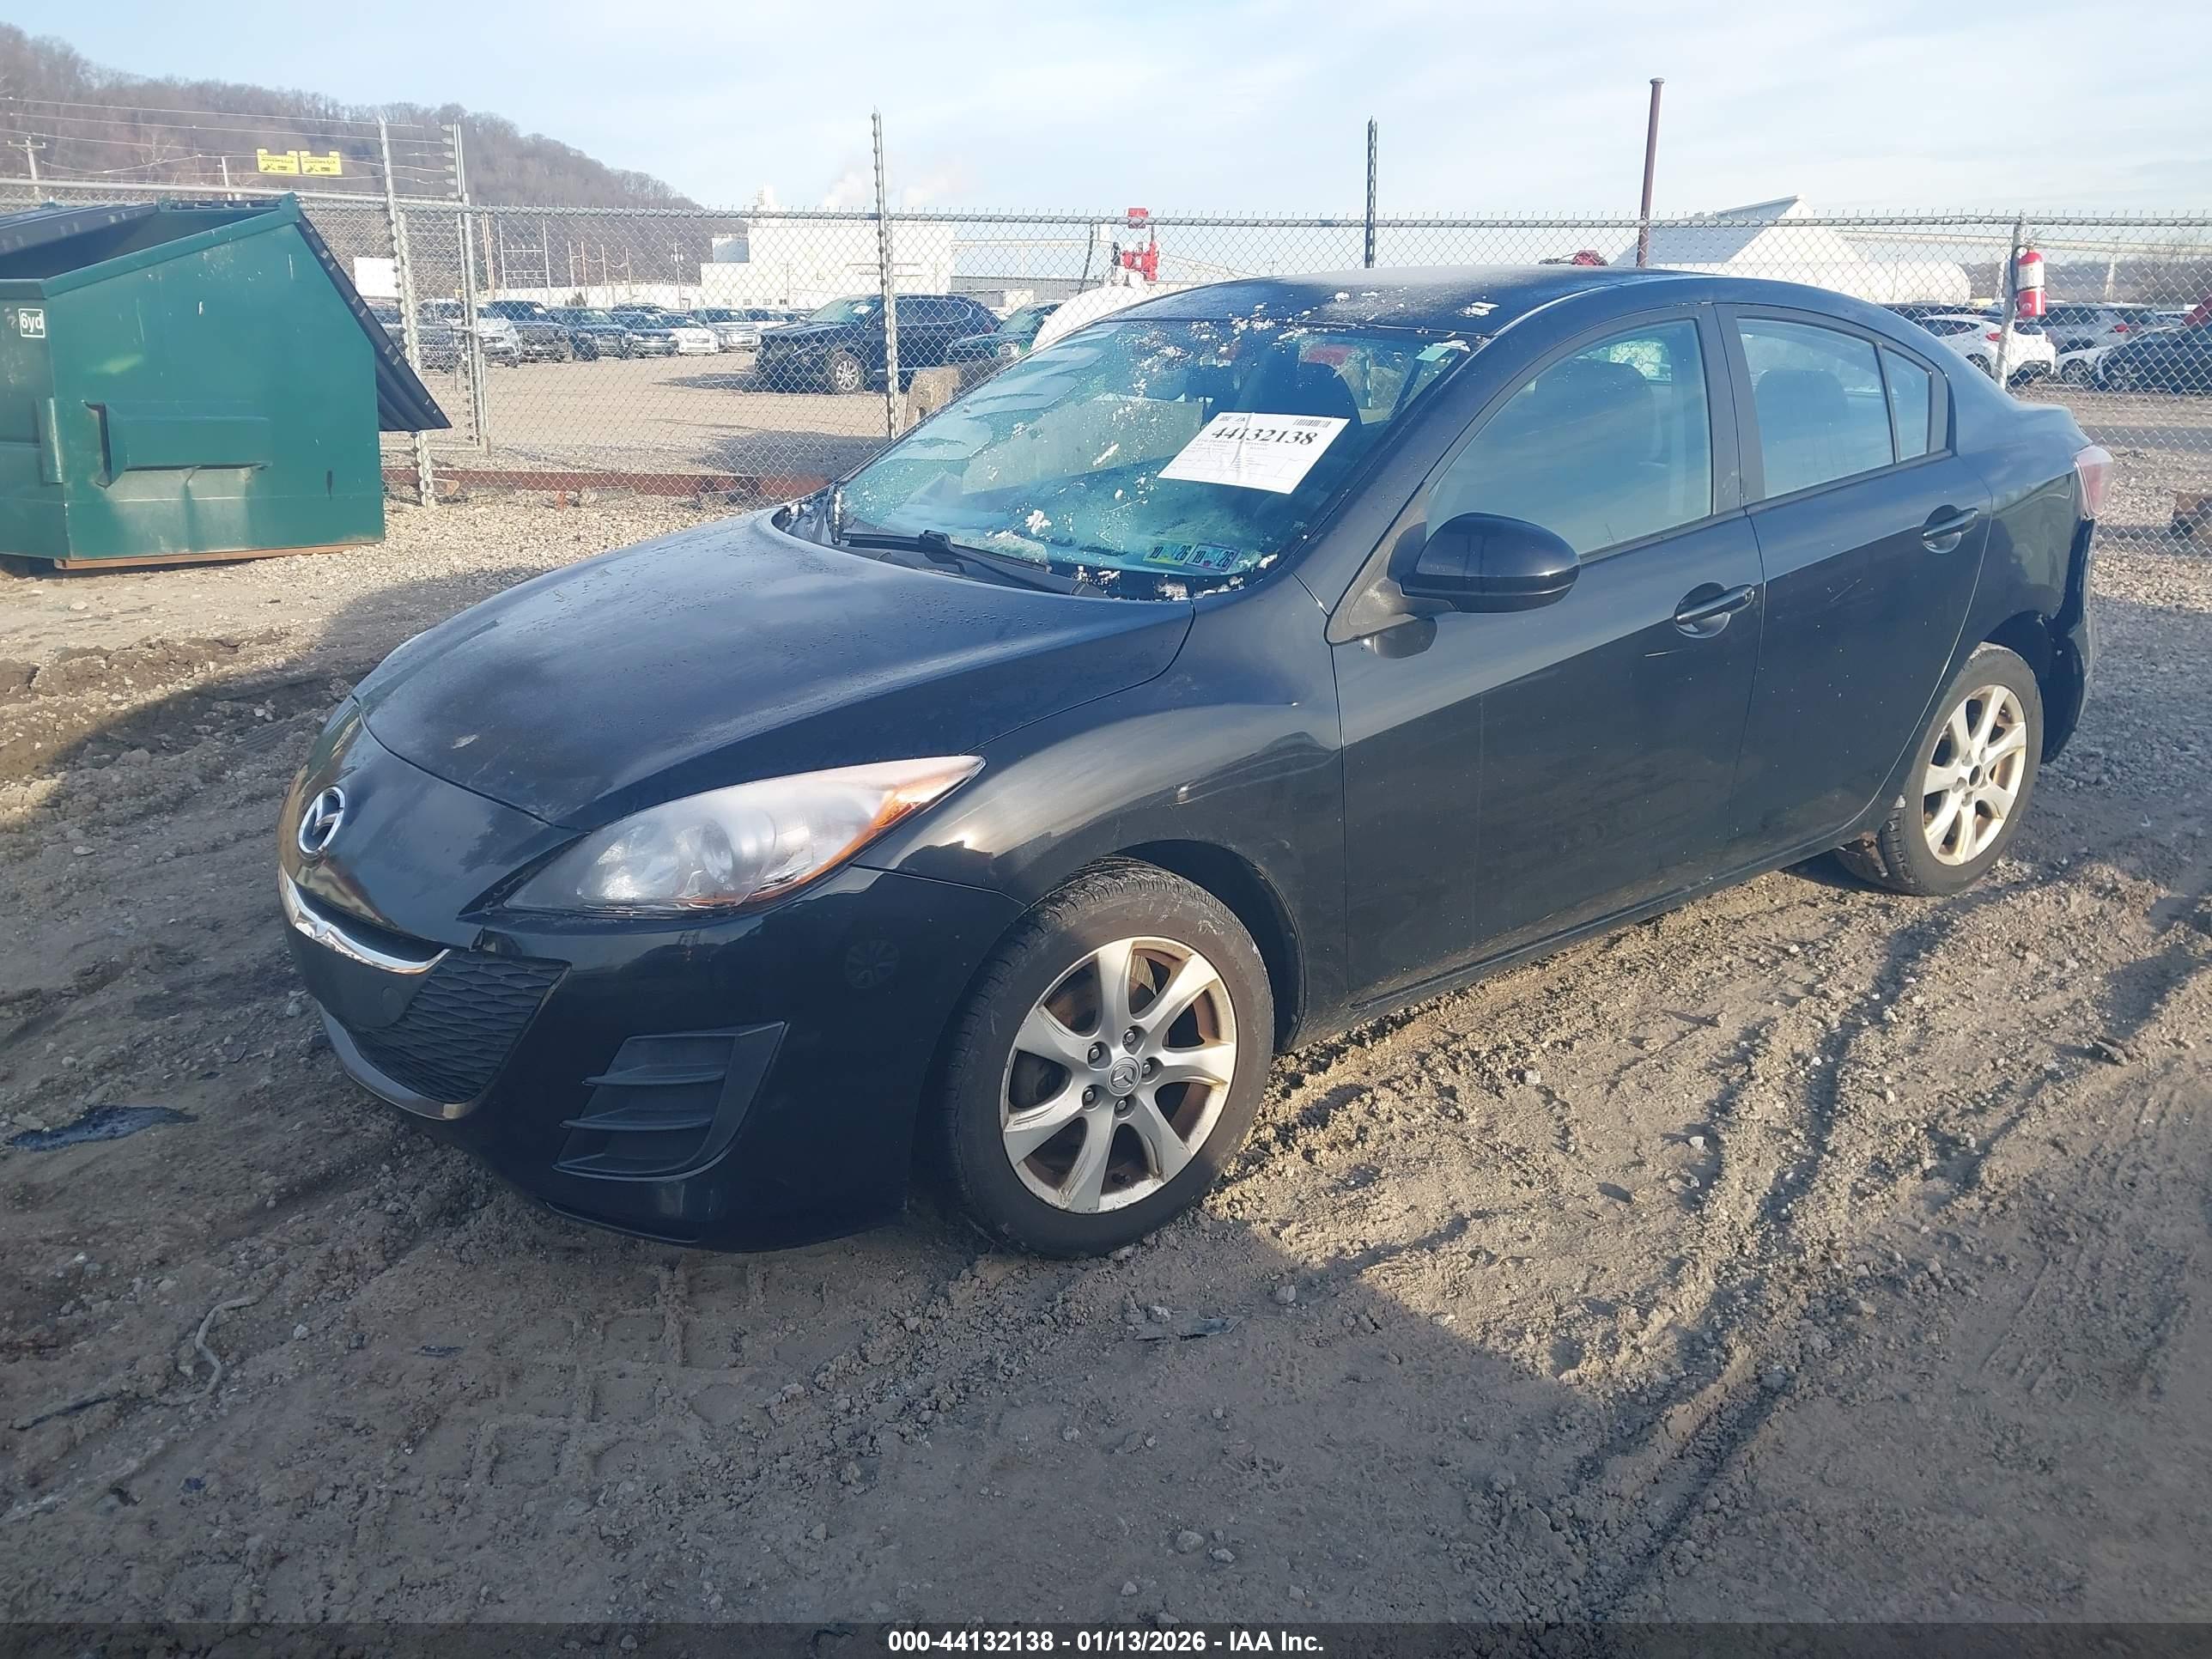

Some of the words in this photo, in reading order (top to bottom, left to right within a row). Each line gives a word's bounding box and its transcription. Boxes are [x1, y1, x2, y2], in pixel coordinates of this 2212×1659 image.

[21, 313, 43, 332] 6yd
[1212, 427, 1318, 446] 44132138
[1174, 544, 1192, 561] 26
[1216, 550, 1235, 568] 26
